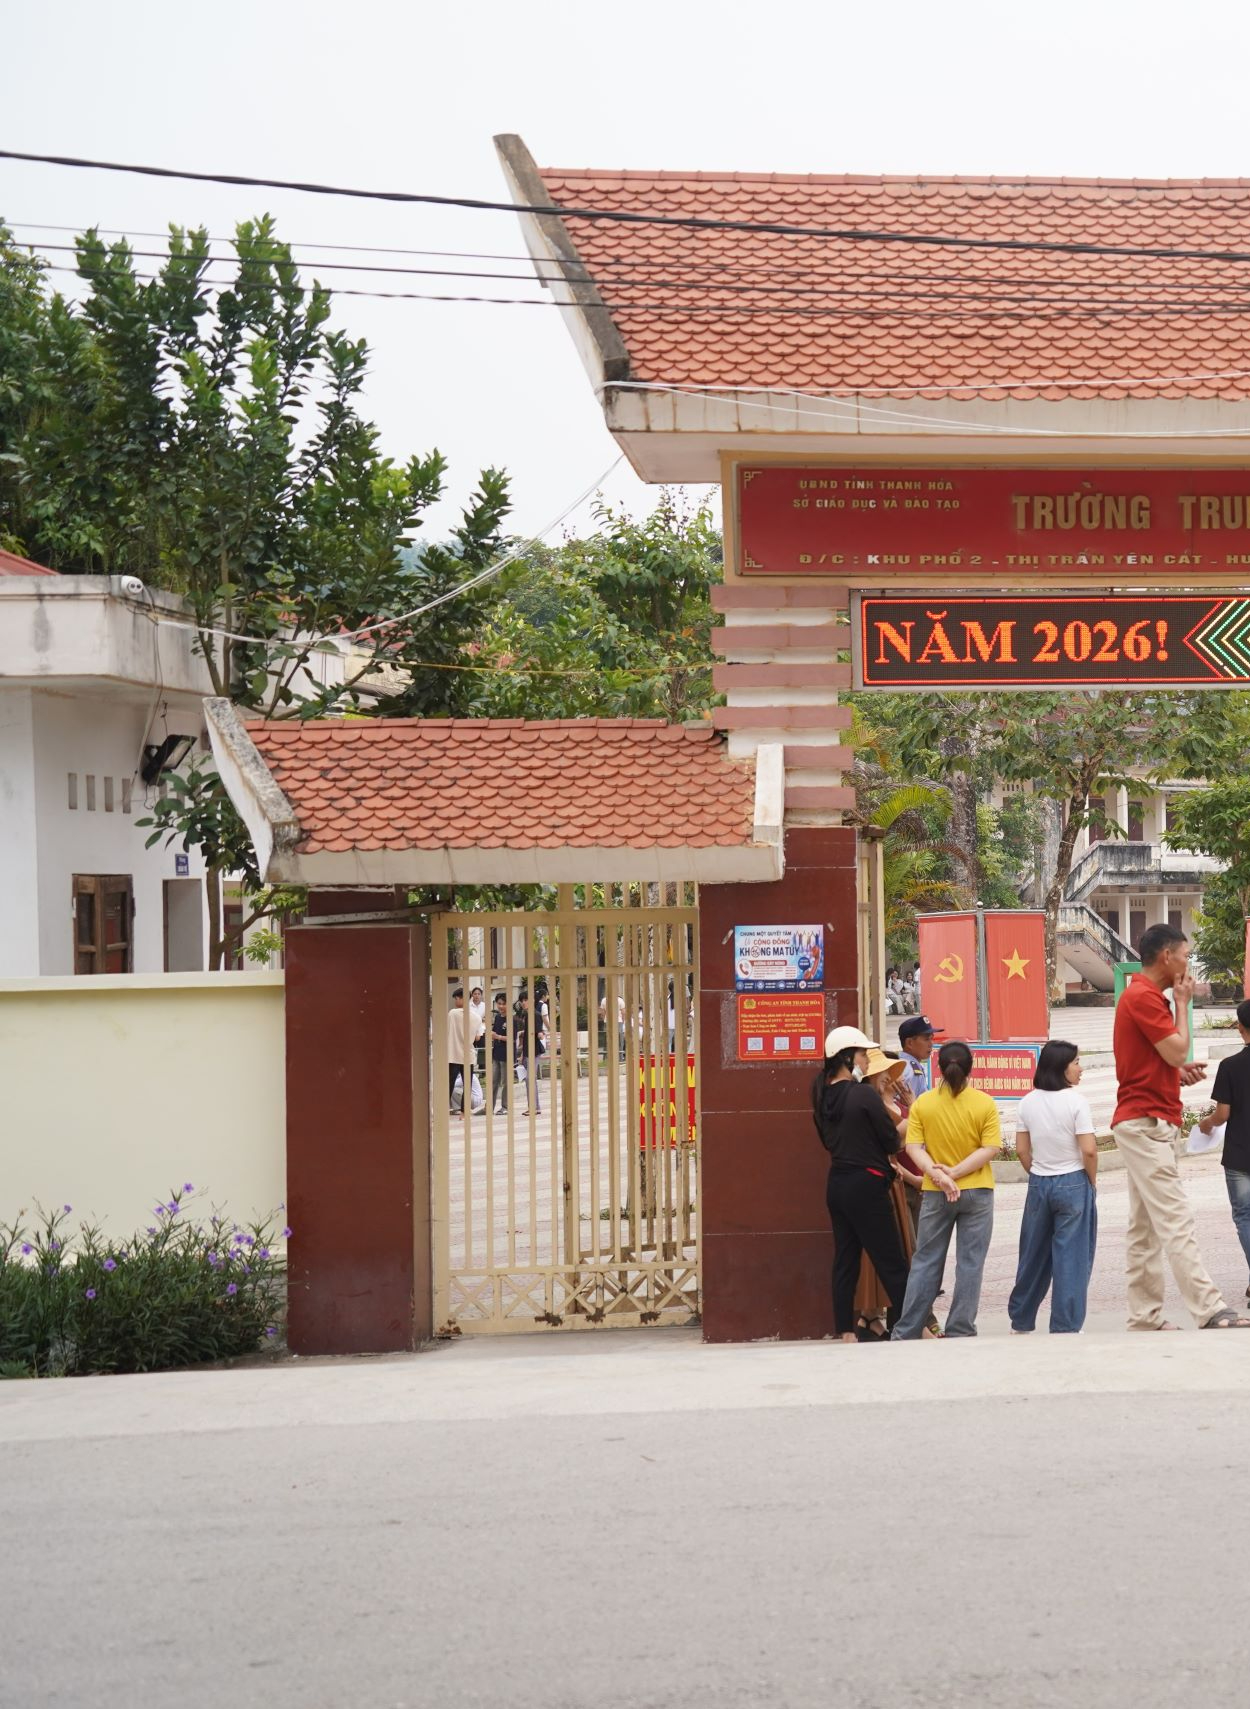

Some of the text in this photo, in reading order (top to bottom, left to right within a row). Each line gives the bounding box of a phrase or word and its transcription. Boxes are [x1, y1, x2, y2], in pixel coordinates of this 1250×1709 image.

[880, 480, 922, 490] THANH
[816, 496, 845, 508] GIÁO
[852, 499, 876, 512] DỤC
[936, 499, 960, 512] TẠO
[1012, 482, 1151, 530] TRƯỜNG
[867, 554, 910, 564] KHU
[970, 555, 982, 565] 2
[1113, 552, 1154, 564] YÊN
[874, 610, 1168, 663] NĂM 2026!
